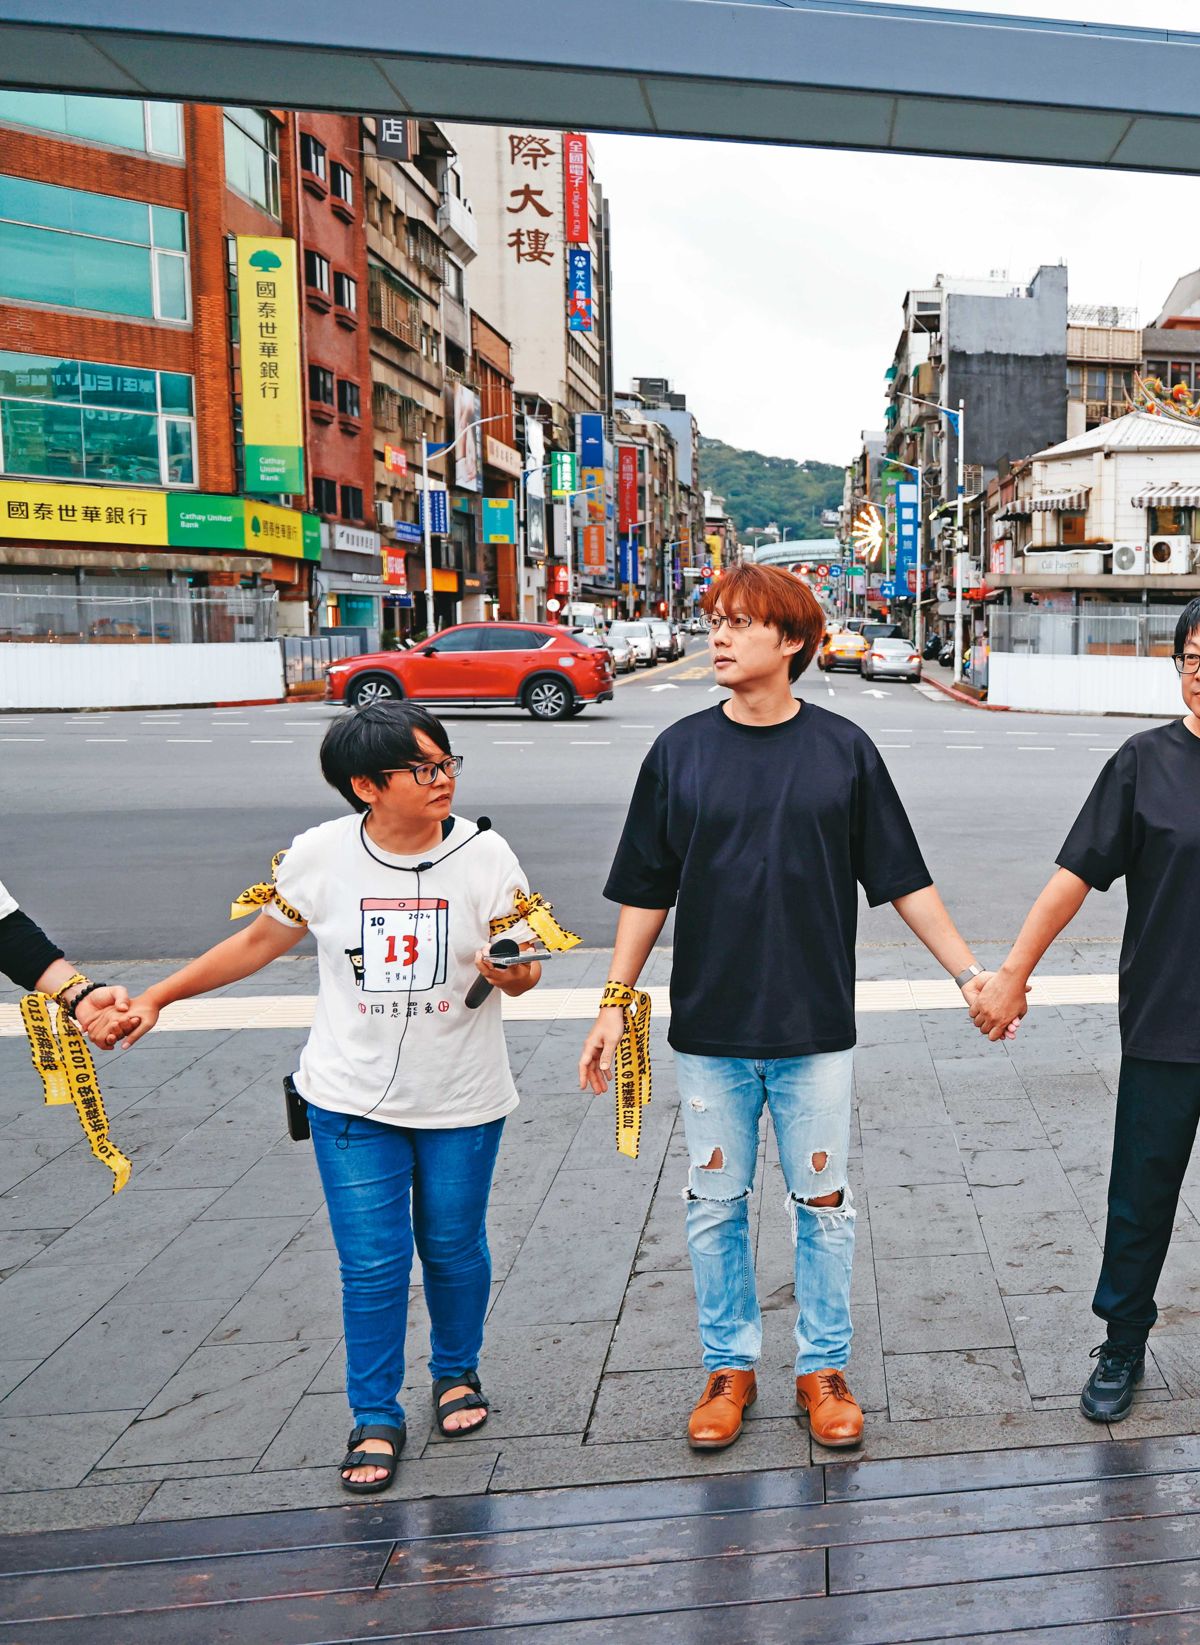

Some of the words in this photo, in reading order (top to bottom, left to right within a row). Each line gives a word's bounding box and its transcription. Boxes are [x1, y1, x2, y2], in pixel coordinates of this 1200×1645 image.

[382, 118, 403, 144] 店
[568, 140, 584, 187] 全國電子
[506, 133, 556, 266] 際大樓
[255, 280, 281, 401] 國泰世華銀行
[259, 457, 286, 467] Cathay
[259, 466, 286, 474] United
[259, 473, 280, 482] Bank
[7, 500, 148, 526] 國泰世華銀行
[179, 512, 206, 522] Cathay
[207, 514, 233, 523] United
[180, 520, 199, 529] Bank
[370, 916, 385, 927] 10
[377, 928, 384, 936] 月
[384, 934, 419, 967] 13
[27, 993, 44, 1022] 1013
[68, 1040, 88, 1070] 1013
